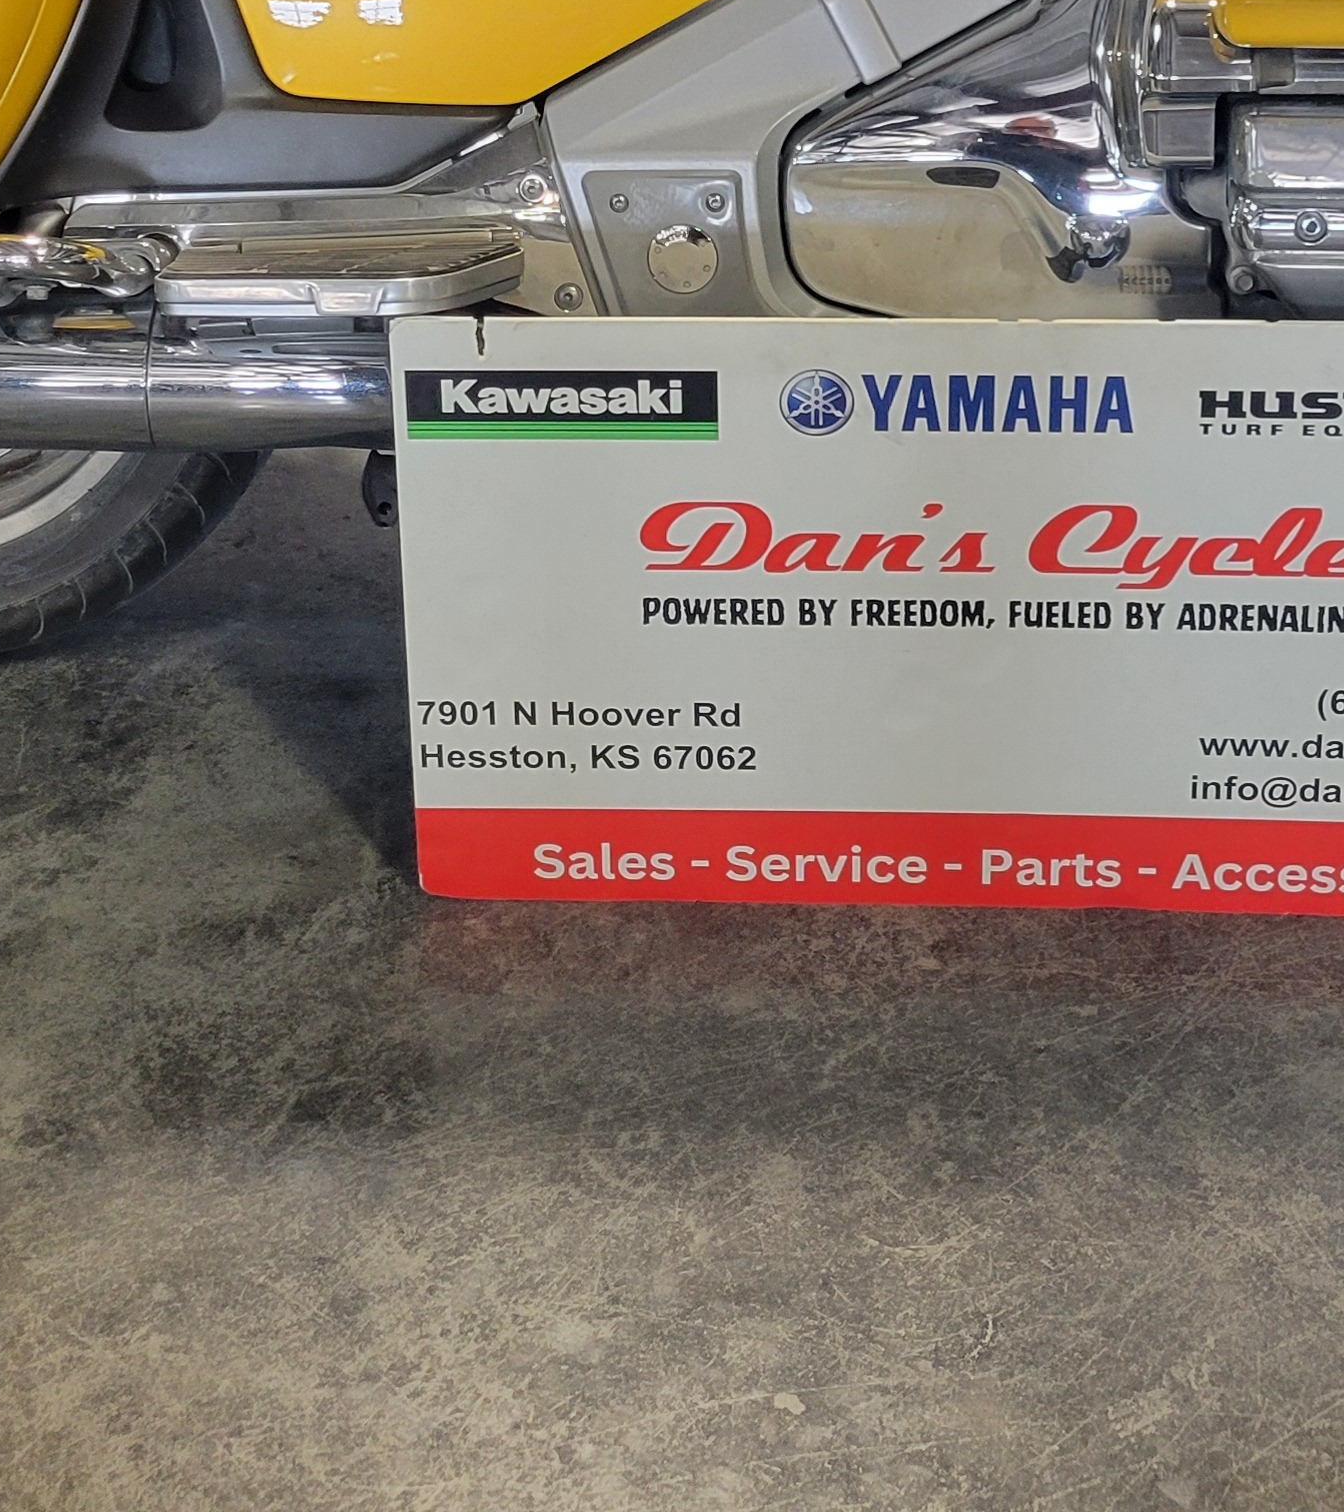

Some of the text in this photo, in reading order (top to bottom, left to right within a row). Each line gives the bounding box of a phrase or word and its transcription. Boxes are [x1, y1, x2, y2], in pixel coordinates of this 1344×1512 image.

[440, 379, 683, 415] Kawasaki
[862, 374, 1134, 433] YAMAHA
[1200, 423, 1283, 436] TURF
[640, 501, 994, 574] Dan's
[643, 597, 785, 626] POWERED
[798, 598, 838, 627] BY
[850, 599, 996, 629] FREEDOM,
[1008, 600, 1112, 630] FUELED
[1125, 602, 1166, 631] BY
[417, 700, 741, 728] 7901 N Hoover Rd
[421, 744, 757, 775] Hesston, KS 67062
[533, 842, 676, 881] Sales
[725, 844, 927, 884] Service
[981, 849, 1122, 888] Parts
